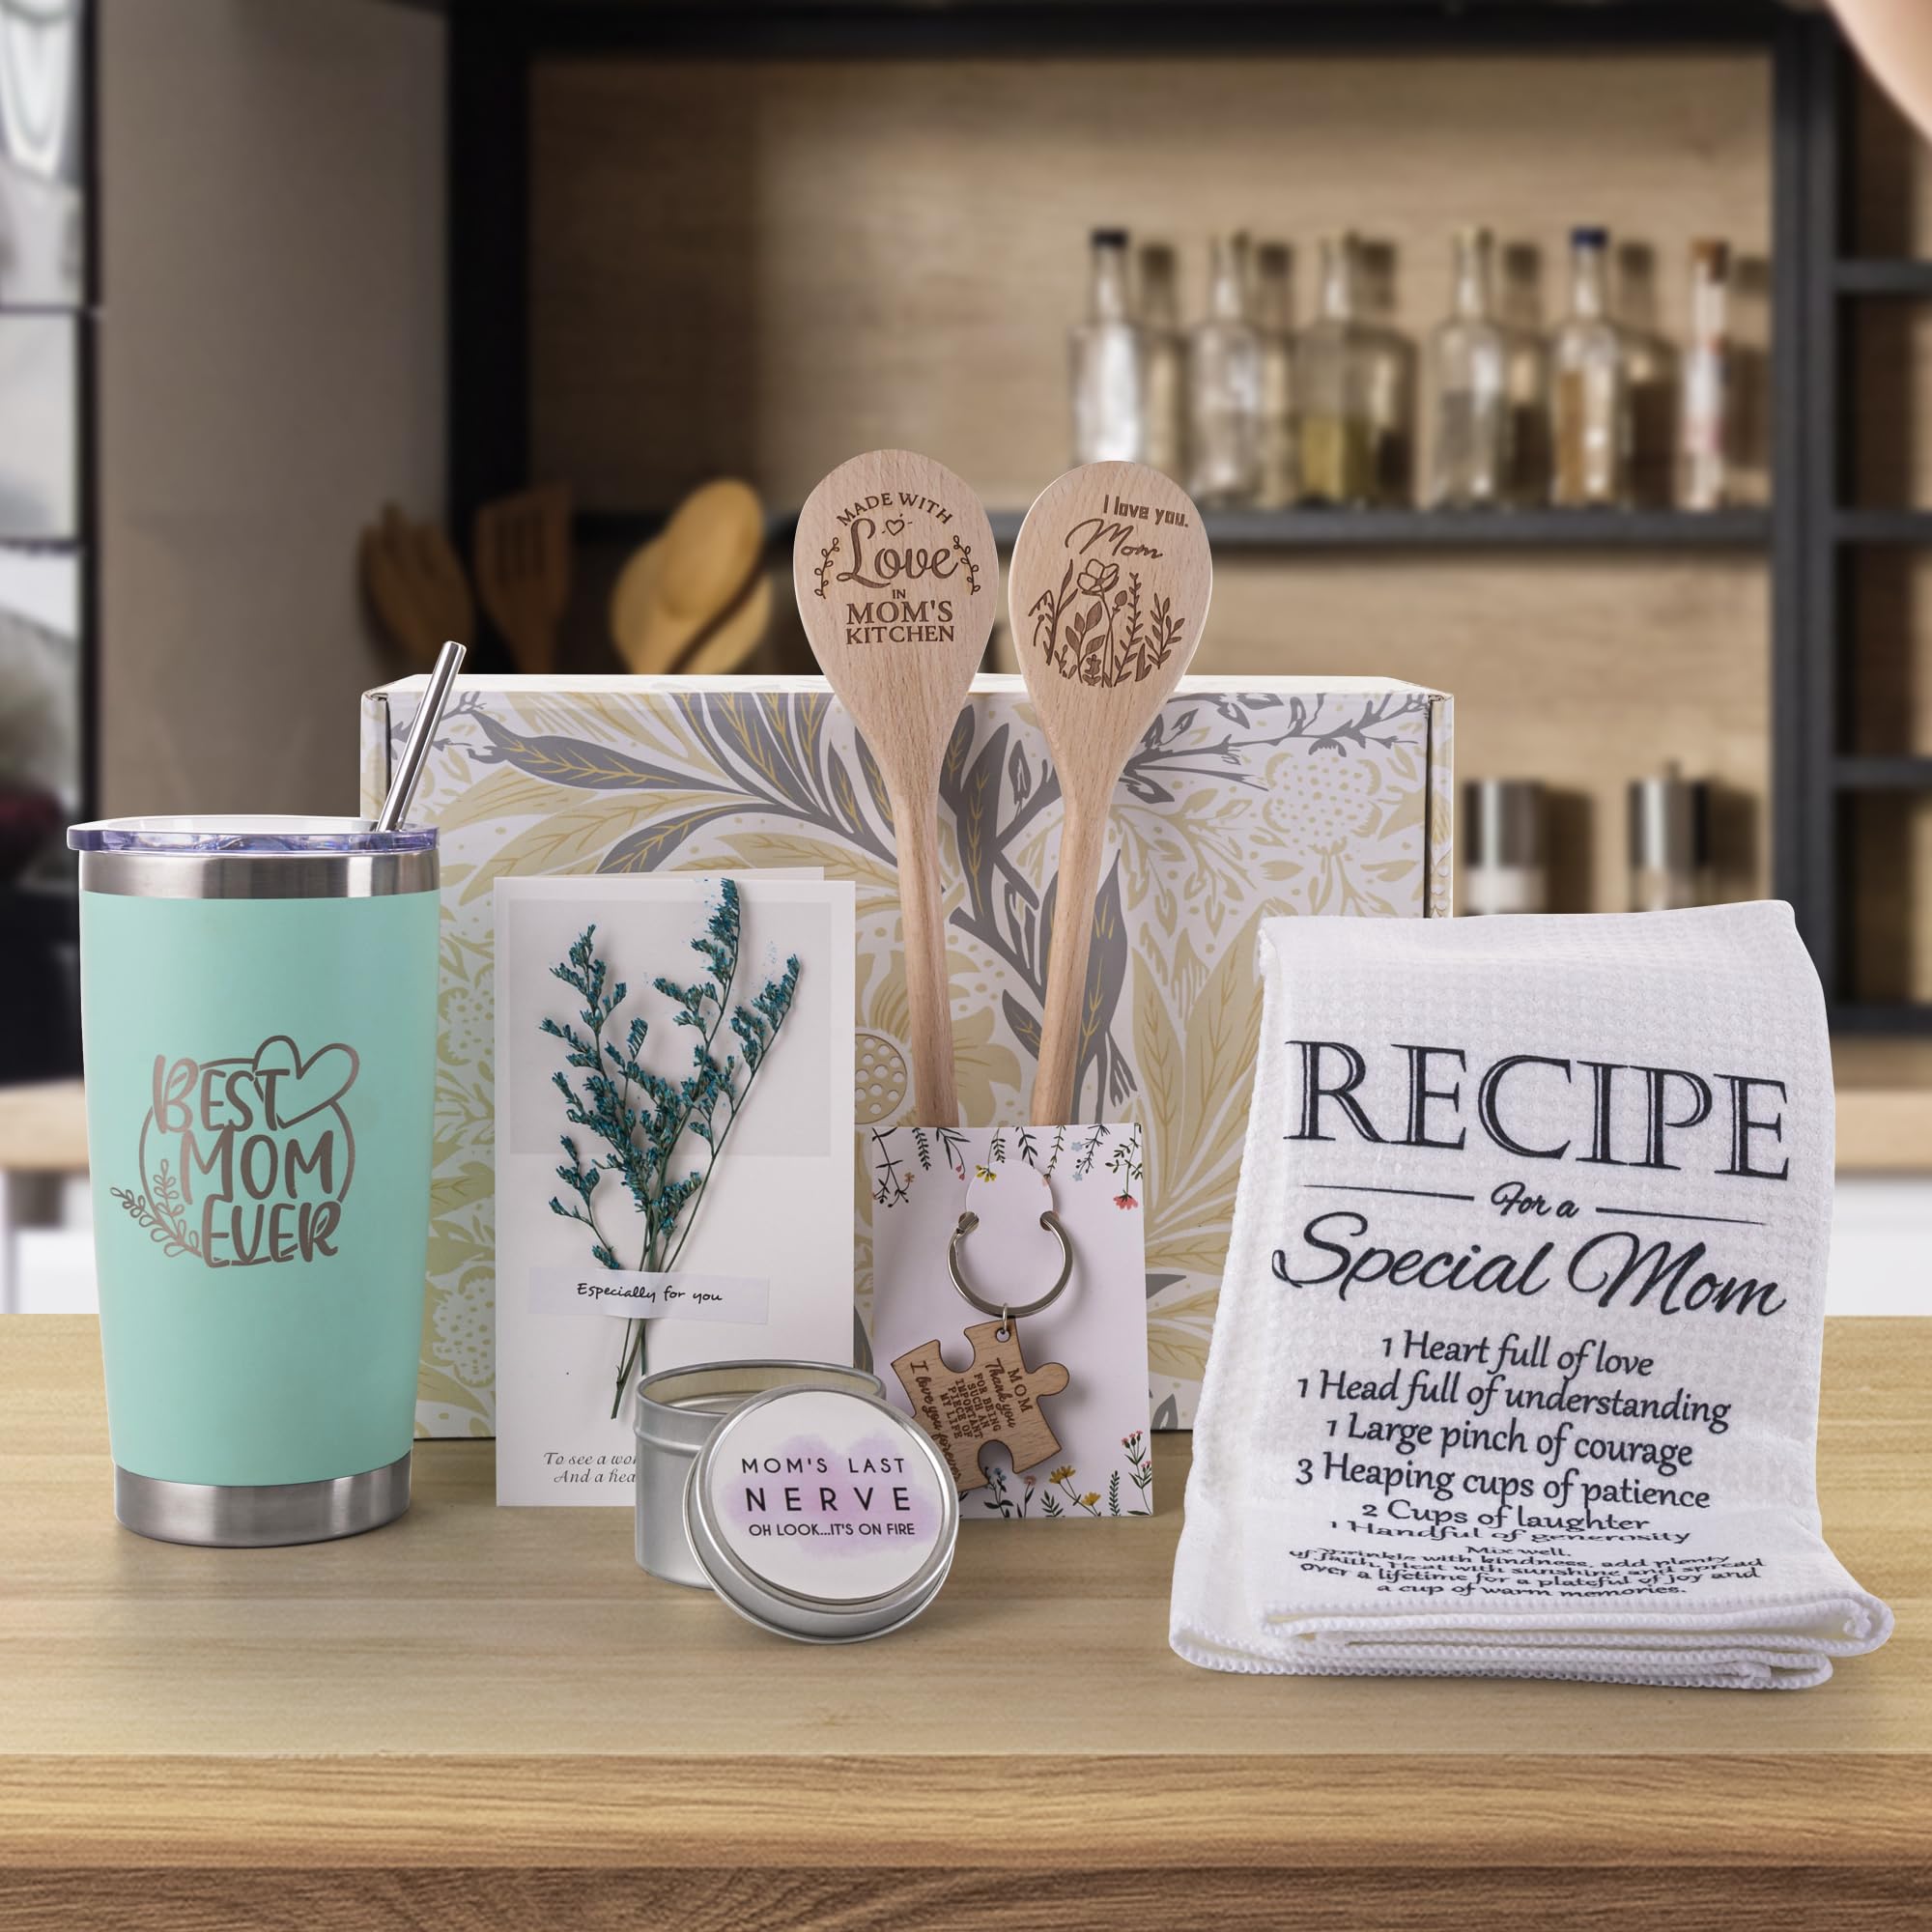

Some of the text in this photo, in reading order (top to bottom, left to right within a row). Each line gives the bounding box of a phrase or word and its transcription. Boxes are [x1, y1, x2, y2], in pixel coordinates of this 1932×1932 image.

[837, 492, 953, 526] MADE WITH
[1103, 495, 1189, 528] I love you.
[837, 518, 958, 588] Love
[1065, 518, 1163, 559] Mom
[892, 588, 906, 599] IN
[846, 600, 954, 625] MOM'S
[846, 625, 954, 644] KITCHEN
[153, 1055, 290, 1134] BEST
[1283, 1040, 1789, 1180] RECIPE
[180, 1120, 334, 1205] MOM
[1491, 1181, 1580, 1218] For a
[202, 1193, 342, 1268] EVER
[1272, 1211, 1787, 1316] Special Mom
[577, 1283, 723, 1304] Especially for you
[910, 1360, 928, 1374] I
[1382, 1329, 1654, 1380] 1 Heart full of love
[916, 1377, 933, 1405] love
[967, 1382, 990, 1429] SUCH AN
[974, 1373, 1002, 1432] FOR BEING
[985, 1357, 1015, 1429] Thank you
[1008, 1368, 1033, 1412] MOM
[1297, 1368, 1731, 1434] 1 Head full of understanding
[922, 1405, 943, 1430] you
[940, 1393, 962, 1438] MY LIFE
[948, 1386, 973, 1437] PIECE OF
[955, 1378, 983, 1438] IMPORTANT
[544, 1452, 564, 1465] To
[568, 1455, 592, 1464] see
[596, 1455, 606, 1464] a
[1326, 1412, 1693, 1476] 1 Large pinch of courage
[554, 1468, 590, 1483] And
[594, 1473, 603, 1483] a
[741, 1458, 904, 1473] MOM'S LAST
[1295, 1451, 1711, 1509] 3 Heaping cups of patience
[745, 1487, 911, 1511] NERVE
[1362, 1499, 1650, 1532] 2 Cups of laughter
[749, 1523, 771, 1536] OH
[859, 1523, 881, 1535] ON
[887, 1522, 915, 1535] FIRE
[1348, 1520, 1484, 1541] Handful
[1492, 1529, 1527, 1542] of
[1531, 1532, 1690, 1544] generosity
[1422, 1554, 1472, 1563] with
[1602, 1558, 1649, 1567] add
[1465, 1546, 1514, 1554] Mix
[1300, 1563, 1350, 1577] over
[1357, 1571, 1372, 1579] a
[1379, 1568, 1467, 1583] lifetime
[1472, 1573, 1511, 1584] for
[1538, 1576, 1633, 1588] plateful
[1662, 1575, 1703, 1584] joy
[1711, 1567, 1761, 1579] and
[1399, 1583, 1444, 1595] cup
[1451, 1582, 1477, 1596] of
[1480, 1586, 1553, 1596] warm
